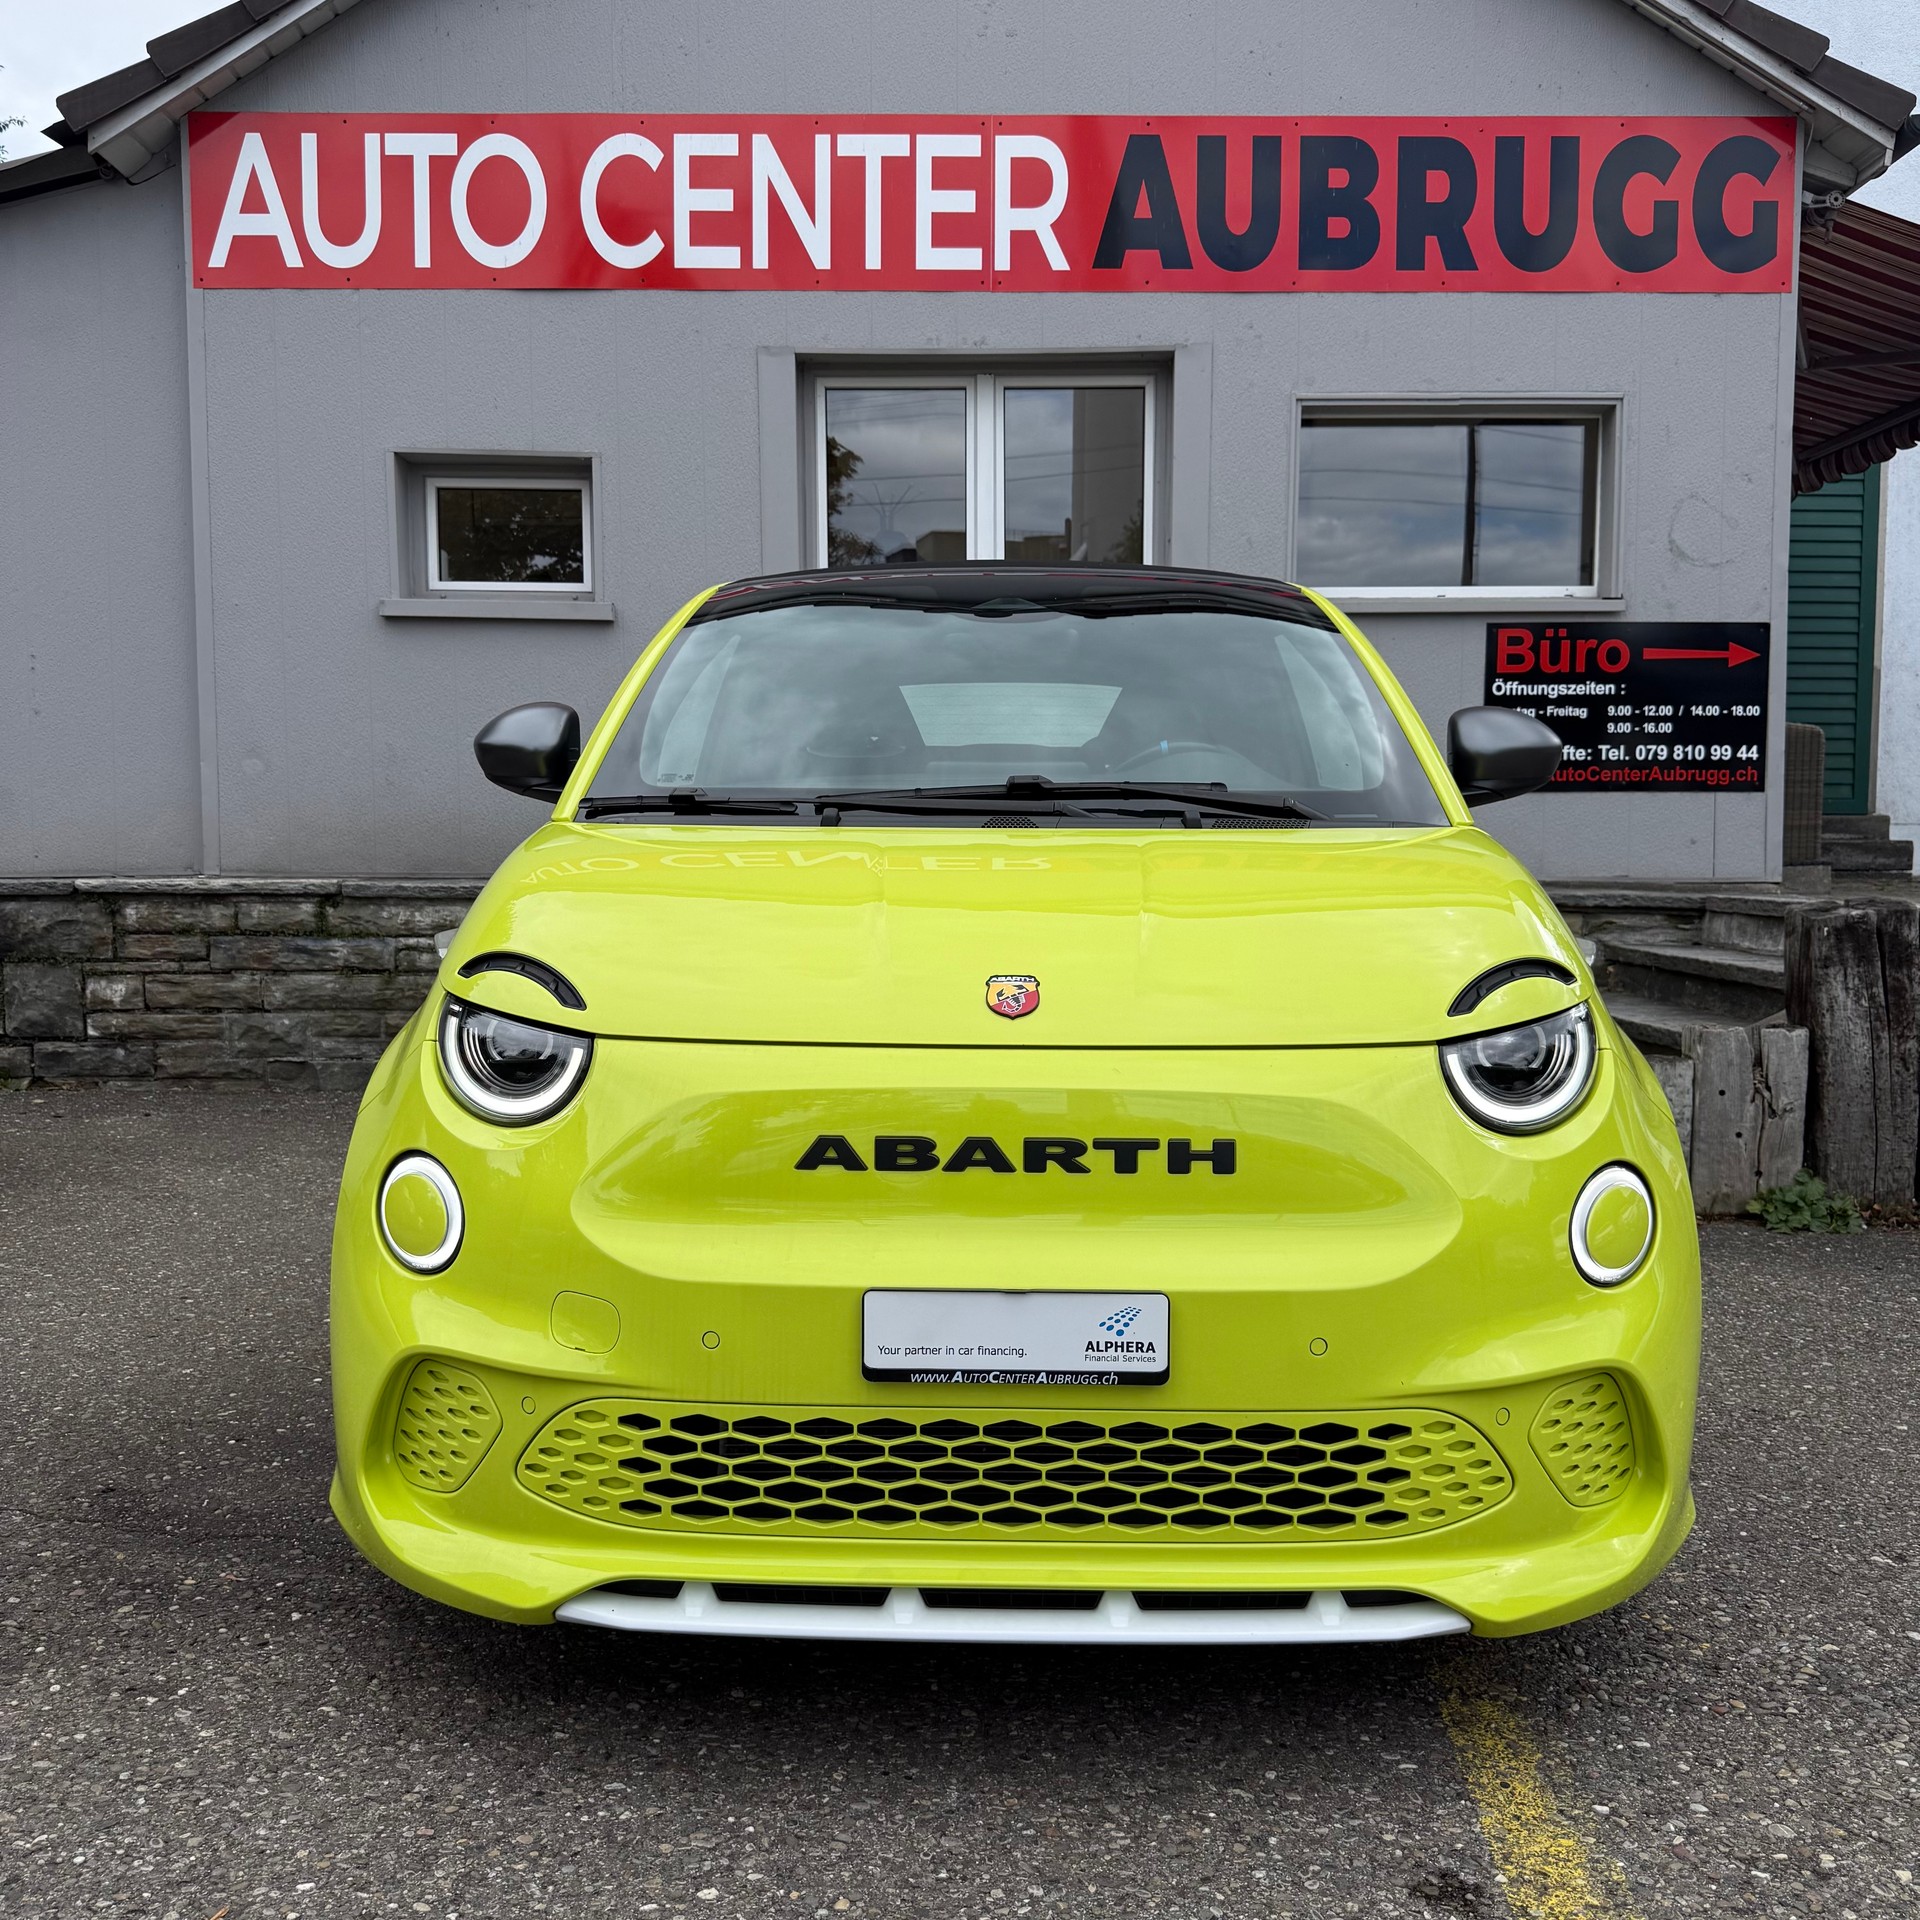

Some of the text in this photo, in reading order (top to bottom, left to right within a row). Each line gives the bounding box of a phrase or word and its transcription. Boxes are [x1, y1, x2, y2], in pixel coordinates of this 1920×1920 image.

[208, 132, 1782, 273] AUTO CENTER AUBRUGG
[1496, 628, 1630, 673] Büro
[1492, 678, 1615, 698] Öffnungszeiten
[1546, 705, 1588, 719] Freitag
[1607, 705, 1632, 717] 9.00
[1642, 705, 1673, 717] 12.00
[1690, 705, 1720, 717] 14.00
[1730, 705, 1761, 717] 18.00
[1607, 722, 1632, 734] 9.00
[1642, 722, 1673, 734] 16.00
[1598, 744, 1630, 761] Tel.
[1635, 744, 1668, 761] 079
[1673, 744, 1705, 761] 810
[1710, 744, 1732, 761] 99
[1736, 744, 1760, 761] 44
[1550, 765, 1759, 786] utoCenterAubrugg.ch
[794, 1135, 1237, 1175] ABARTH
[878, 1345, 1028, 1359] Your partner in car financing.
[1085, 1340, 1156, 1354] ALPHERA
[1084, 1354, 1157, 1363] Financial Services
